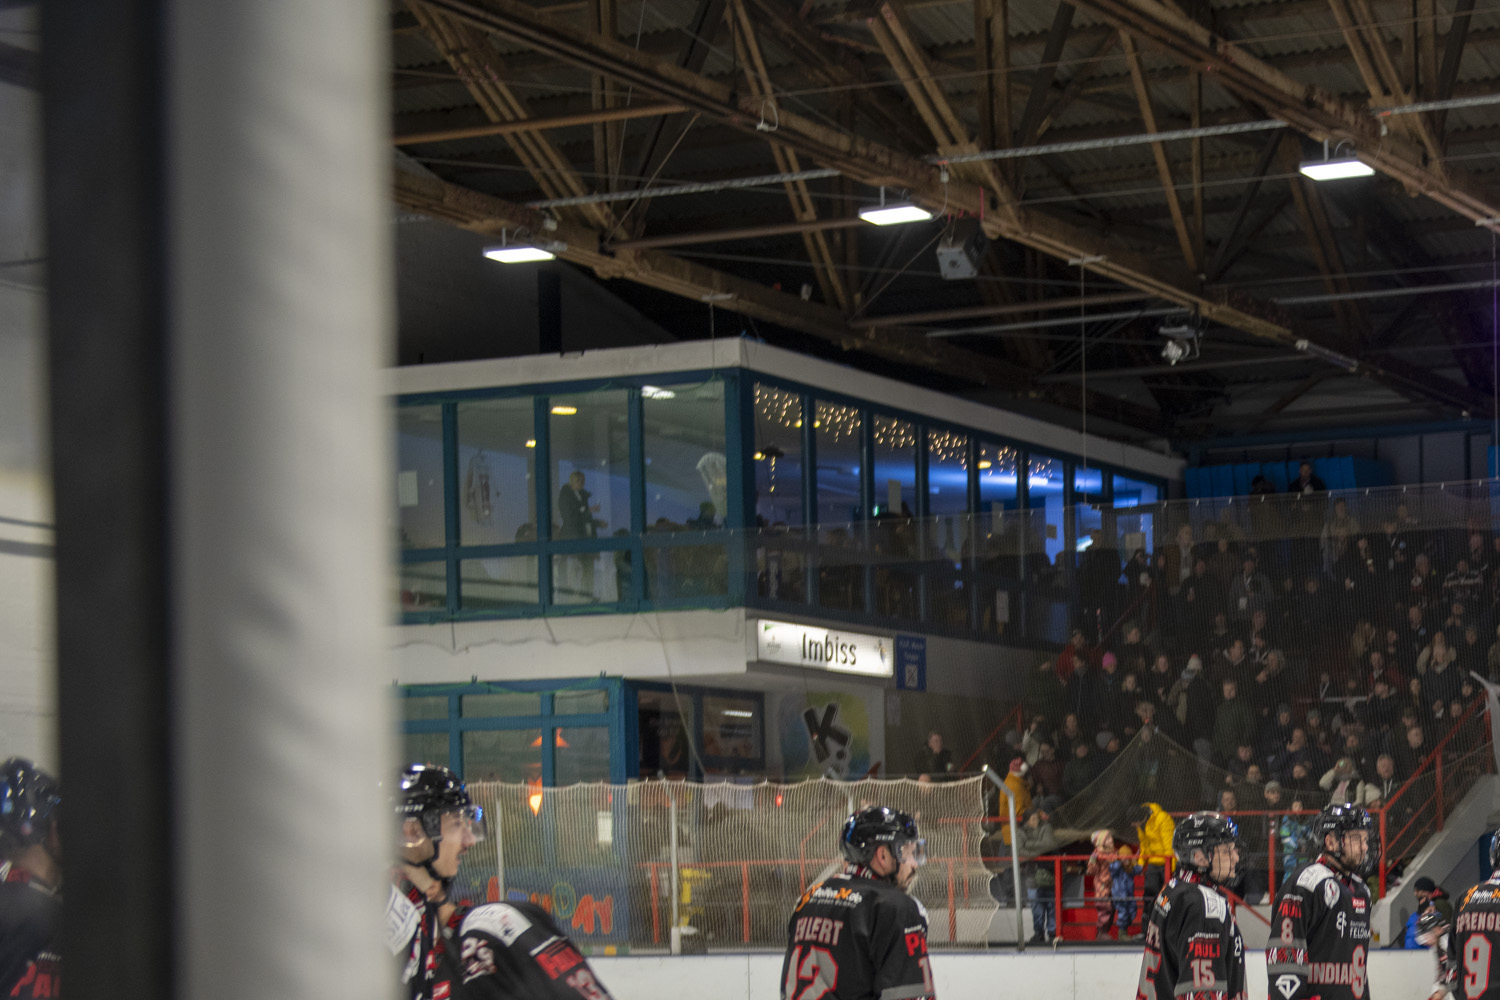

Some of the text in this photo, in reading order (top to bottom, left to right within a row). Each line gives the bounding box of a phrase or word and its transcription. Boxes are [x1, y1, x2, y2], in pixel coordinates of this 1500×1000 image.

[803, 632, 857, 665] Imbiss
[1281, 917, 1293, 945] 8
[1190, 958, 1215, 989] 15
[1463, 933, 1492, 1000] 9
